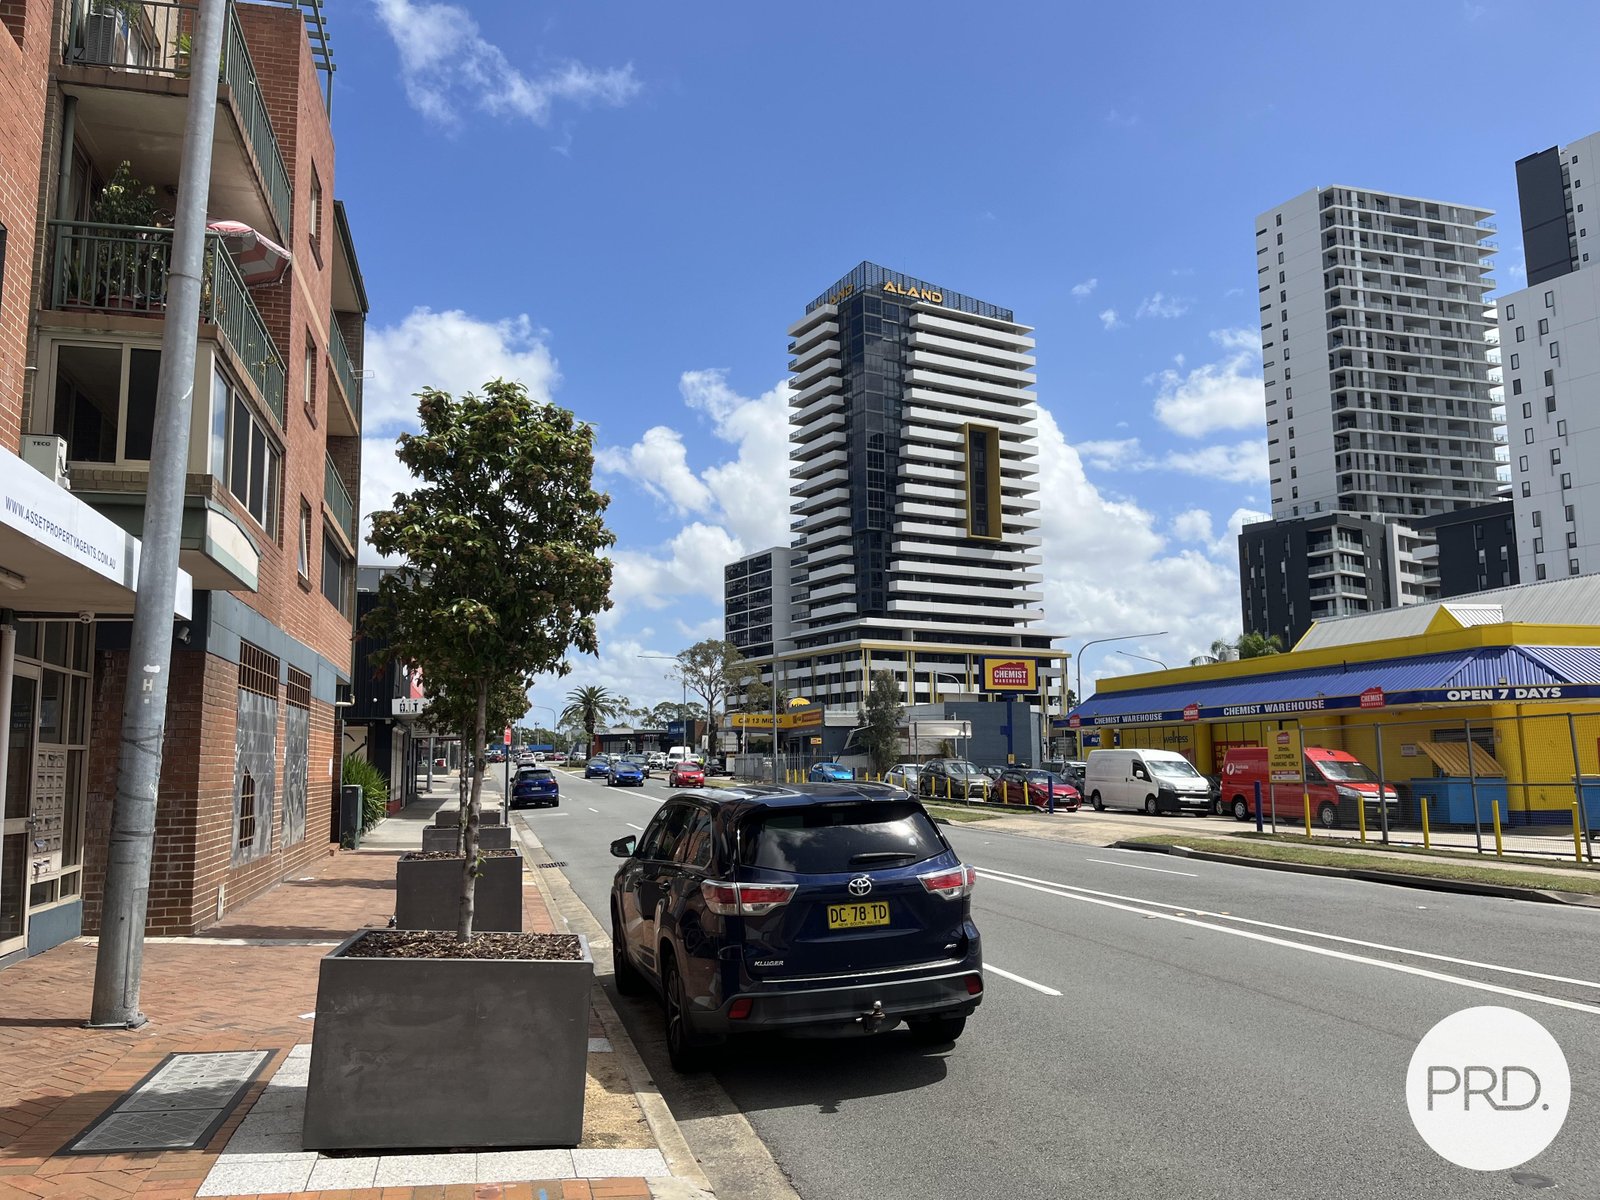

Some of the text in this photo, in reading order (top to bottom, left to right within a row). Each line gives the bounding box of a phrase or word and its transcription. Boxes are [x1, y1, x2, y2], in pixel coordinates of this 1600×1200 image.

[883, 281, 943, 303] ALAND
[5, 496, 117, 570] WWW.ASSETPROPERTYAGENTS.COM.AU
[994, 670, 1027, 678] CHEMIST
[1360, 694, 1384, 702] CHEMIST
[1447, 687, 1562, 701] OPEN 7 DAYS
[1222, 700, 1325, 716] CHEMIST WAREHOUSE
[1094, 713, 1163, 725] CHEMIST WAREHOUSE
